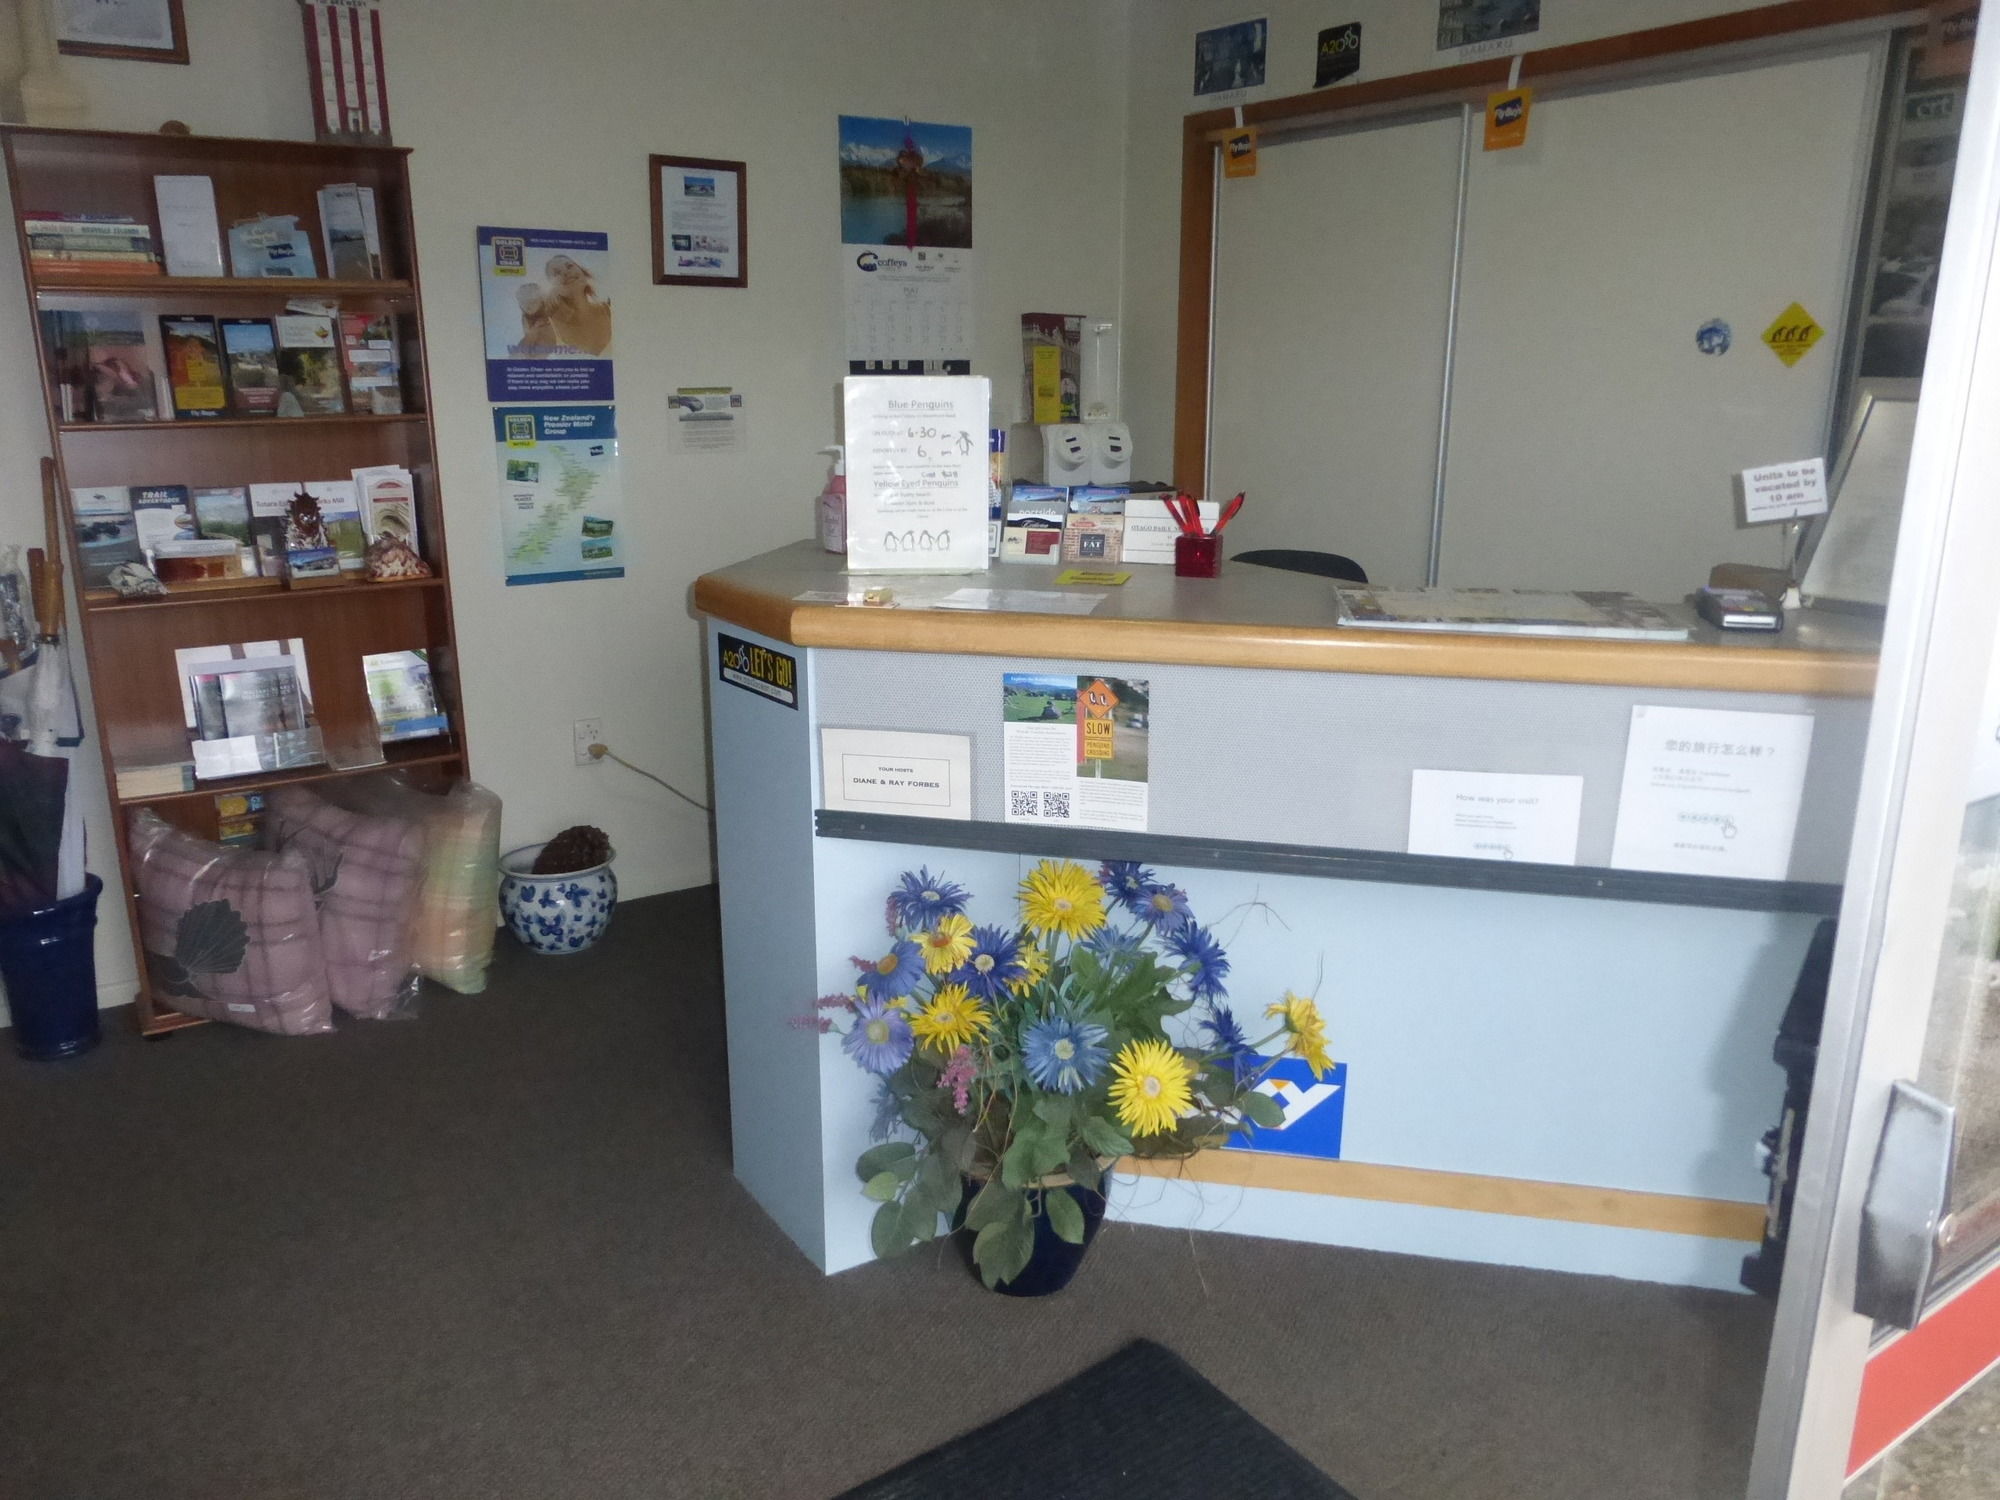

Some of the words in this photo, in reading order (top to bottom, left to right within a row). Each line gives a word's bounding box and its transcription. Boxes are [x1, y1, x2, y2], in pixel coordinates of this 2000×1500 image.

[888, 400, 909, 409] Blue
[910, 400, 954, 411] Penguins
[573, 420, 593, 428] Motel
[544, 428, 568, 436] Group
[1754, 471, 1783, 481] Units
[922, 479, 959, 490] Penguins
[1755, 481, 1800, 492] vacated
[1803, 479, 1816, 487] by
[142, 490, 168, 499] TRAIL
[1770, 494, 1782, 502] 10
[750, 647, 774, 682] LET'S
[776, 656, 793, 689] GO!
[1086, 722, 1111, 735] SLOW
[853, 777, 877, 785] DIANE
[907, 780, 940, 789] FORBES
[1456, 793, 1475, 802] How
[1496, 798, 1515, 806] your
